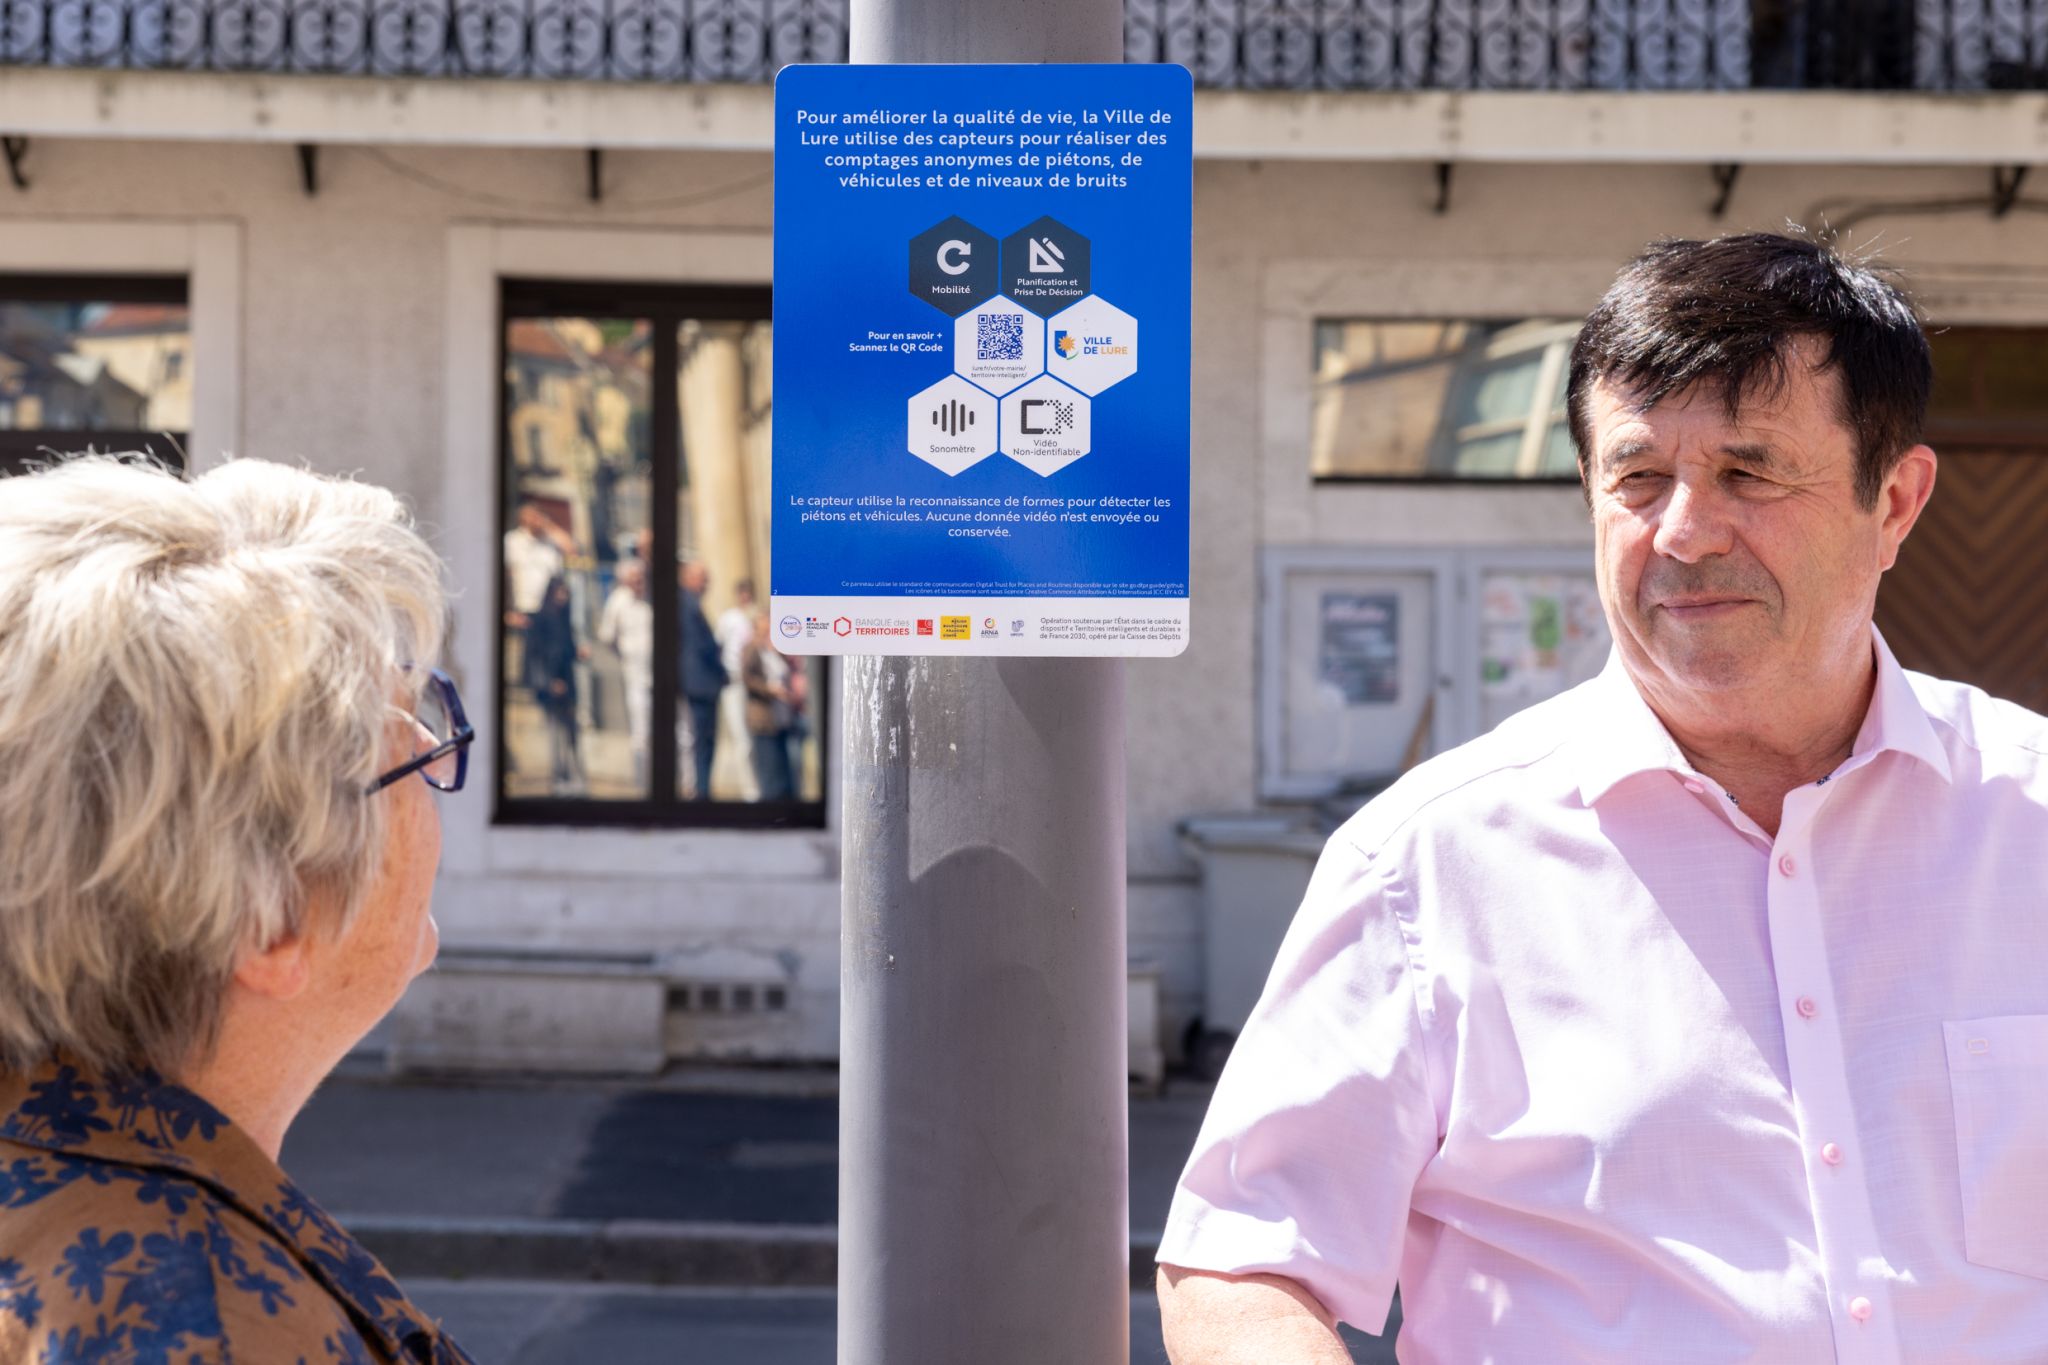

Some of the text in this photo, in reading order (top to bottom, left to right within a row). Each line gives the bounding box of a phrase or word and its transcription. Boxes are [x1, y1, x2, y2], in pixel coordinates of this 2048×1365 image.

[797, 110, 1171, 127] Pour améliorer la qualité de vie, la Ville de
[802, 131, 1167, 149] Lure utilise des capteurs pour réaliser des
[825, 152, 1142, 170] comptages anonymes de piétons, de
[839, 173, 1127, 187] véhicules et de niveaux de bruits
[1017, 278, 1067, 286] Planification
[932, 285, 970, 294] Mobilité
[1014, 288, 1083, 296] Prise De Décision
[868, 331, 891, 340] Pour
[906, 331, 934, 340] savoir
[1084, 337, 1112, 345] VILLE
[849, 343, 943, 354] Scannez le QR Code
[1084, 346, 1097, 354] DE
[930, 445, 976, 453] Sonomètre
[1013, 448, 1081, 456] Non-identifiable
[791, 495, 1171, 509] Le capteur utilise la reconnaissance de formes pour détecter les
[801, 510, 1159, 525] piétons et véhicules. Aucune donnée vidéo n'est envoyée ou
[948, 526, 1011, 537] conservée.
[855, 618, 910, 627] BANQUE des
[1040, 617, 1071, 626] Opération
[1114, 616, 1130, 624] l'État
[1040, 625, 1068, 634] dispositif
[1107, 626, 1140, 634] intelligents
[1159, 633, 1181, 641] Dépôts
